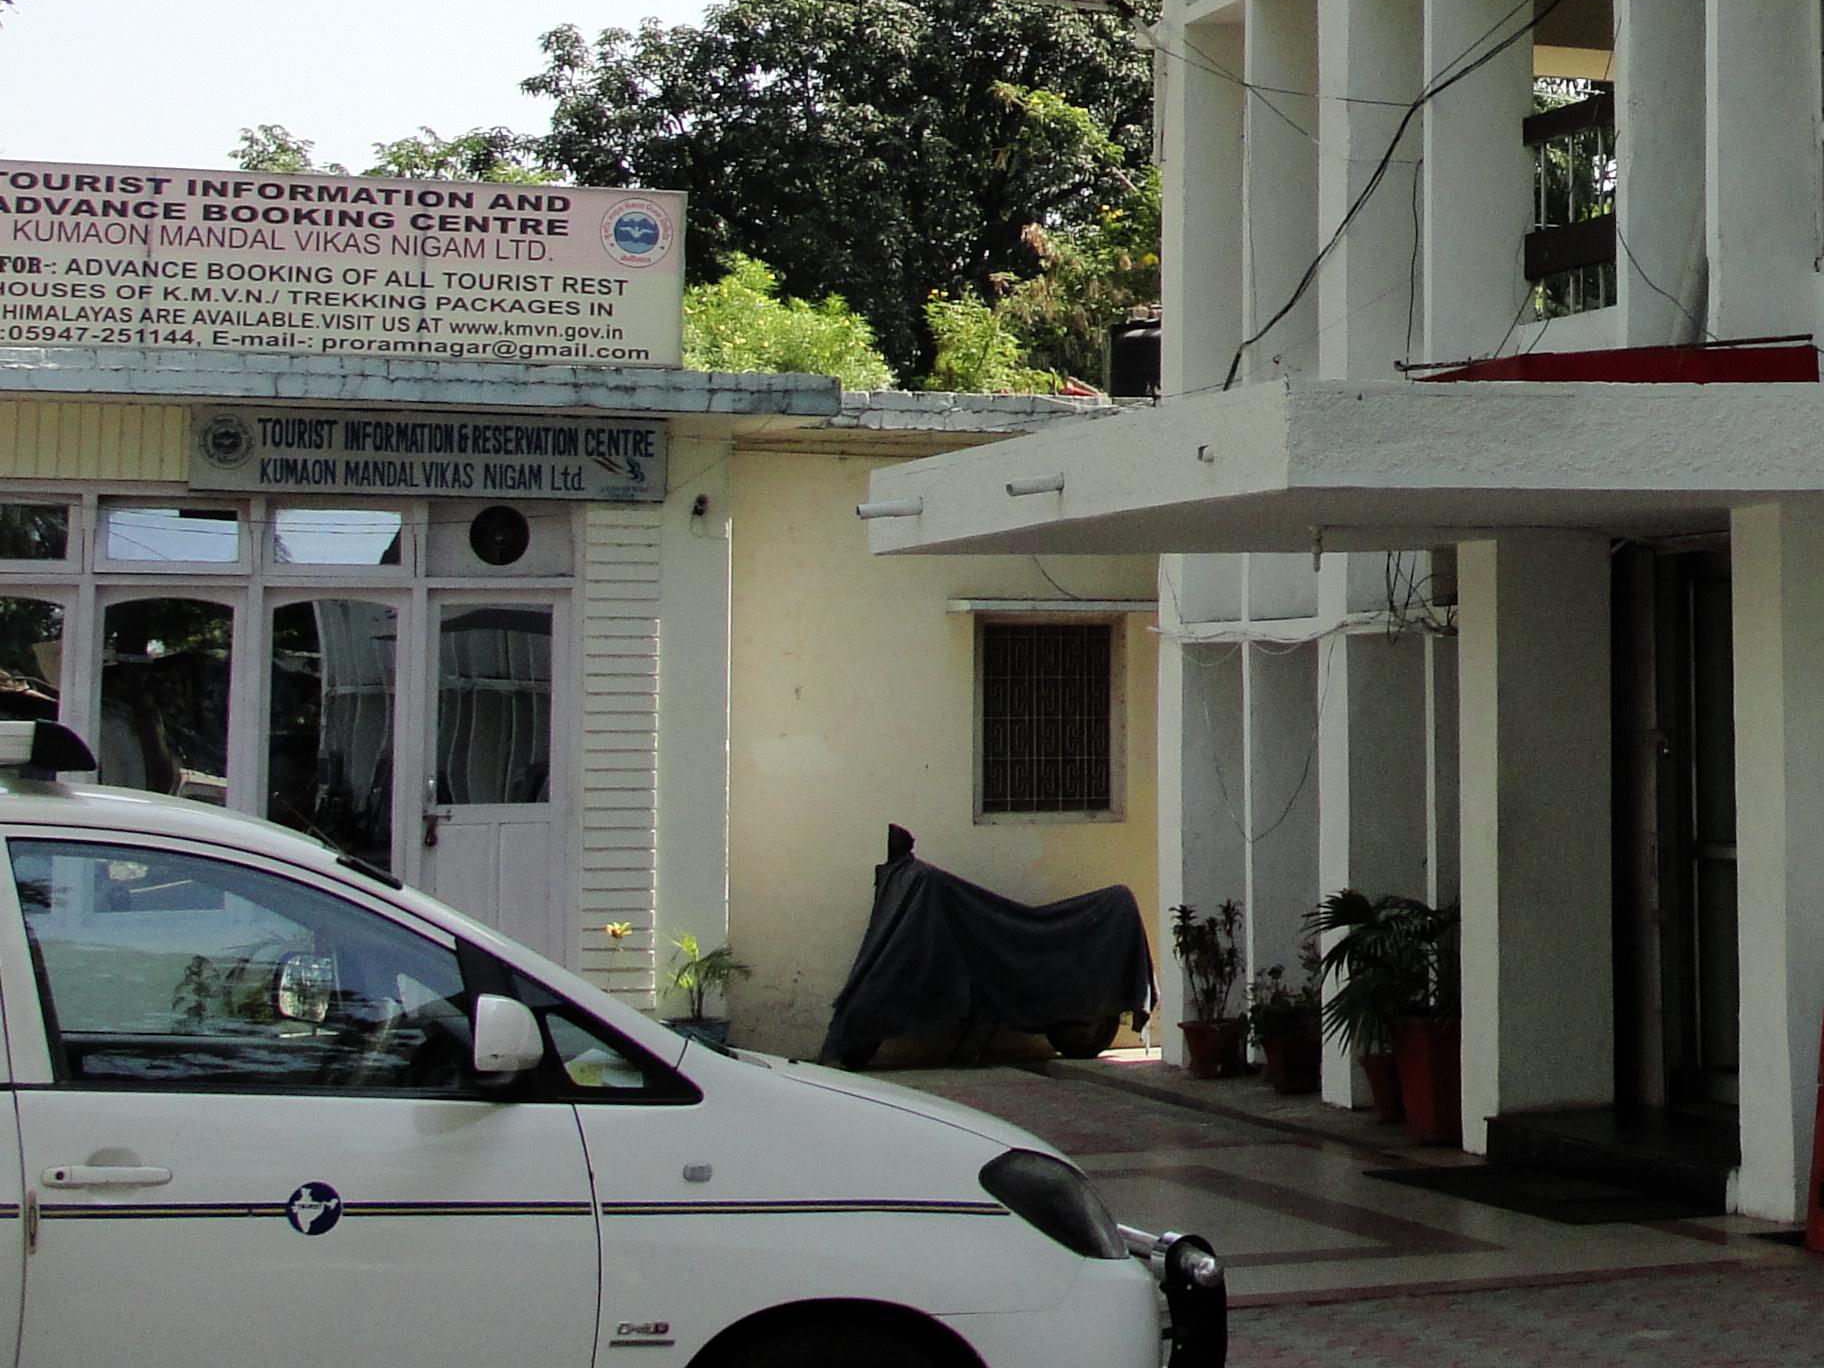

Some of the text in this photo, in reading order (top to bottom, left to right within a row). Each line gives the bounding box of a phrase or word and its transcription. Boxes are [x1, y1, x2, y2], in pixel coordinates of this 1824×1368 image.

[187, 179, 475, 209] INFORMATION
[488, 193, 571, 212] AND
[202, 204, 395, 229] BOOKING
[410, 213, 570, 237] CENTRE
[13, 219, 553, 262] KUMAON MANDAL VIKAS NIGAM LTD.
[64, 258, 198, 279] ADVANCE
[207, 262, 333, 285] BOOKING
[342, 267, 378, 286] OF
[384, 270, 435, 288] ALL
[442, 272, 554, 293] TOURIST
[562, 276, 629, 296] REST
[116, 284, 153, 300] OF
[288, 290, 427, 311] TREKKING
[436, 296, 581, 316] PACKAGES
[589, 302, 614, 317] IN
[2, 303, 133, 324] HIMALAYAS
[139, 308, 186, 325] ARE
[382, 315, 411, 333] US
[416, 317, 443, 333] AT
[449, 320, 624, 342] www.kmvn.gov.in
[322, 337, 650, 361] proramnagar@gmail.com
[257, 417, 338, 449] TOURIST
[344, 420, 454, 454] INFORMATION
[472, 424, 579, 456] RESERVATION
[584, 428, 656, 458] CENTRE
[260, 458, 337, 485] KUMAON
[344, 460, 419, 488] MANDAL
[422, 461, 474, 489] VIKAS
[483, 463, 543, 491] NIGAM
[551, 465, 586, 492] Ltd.
